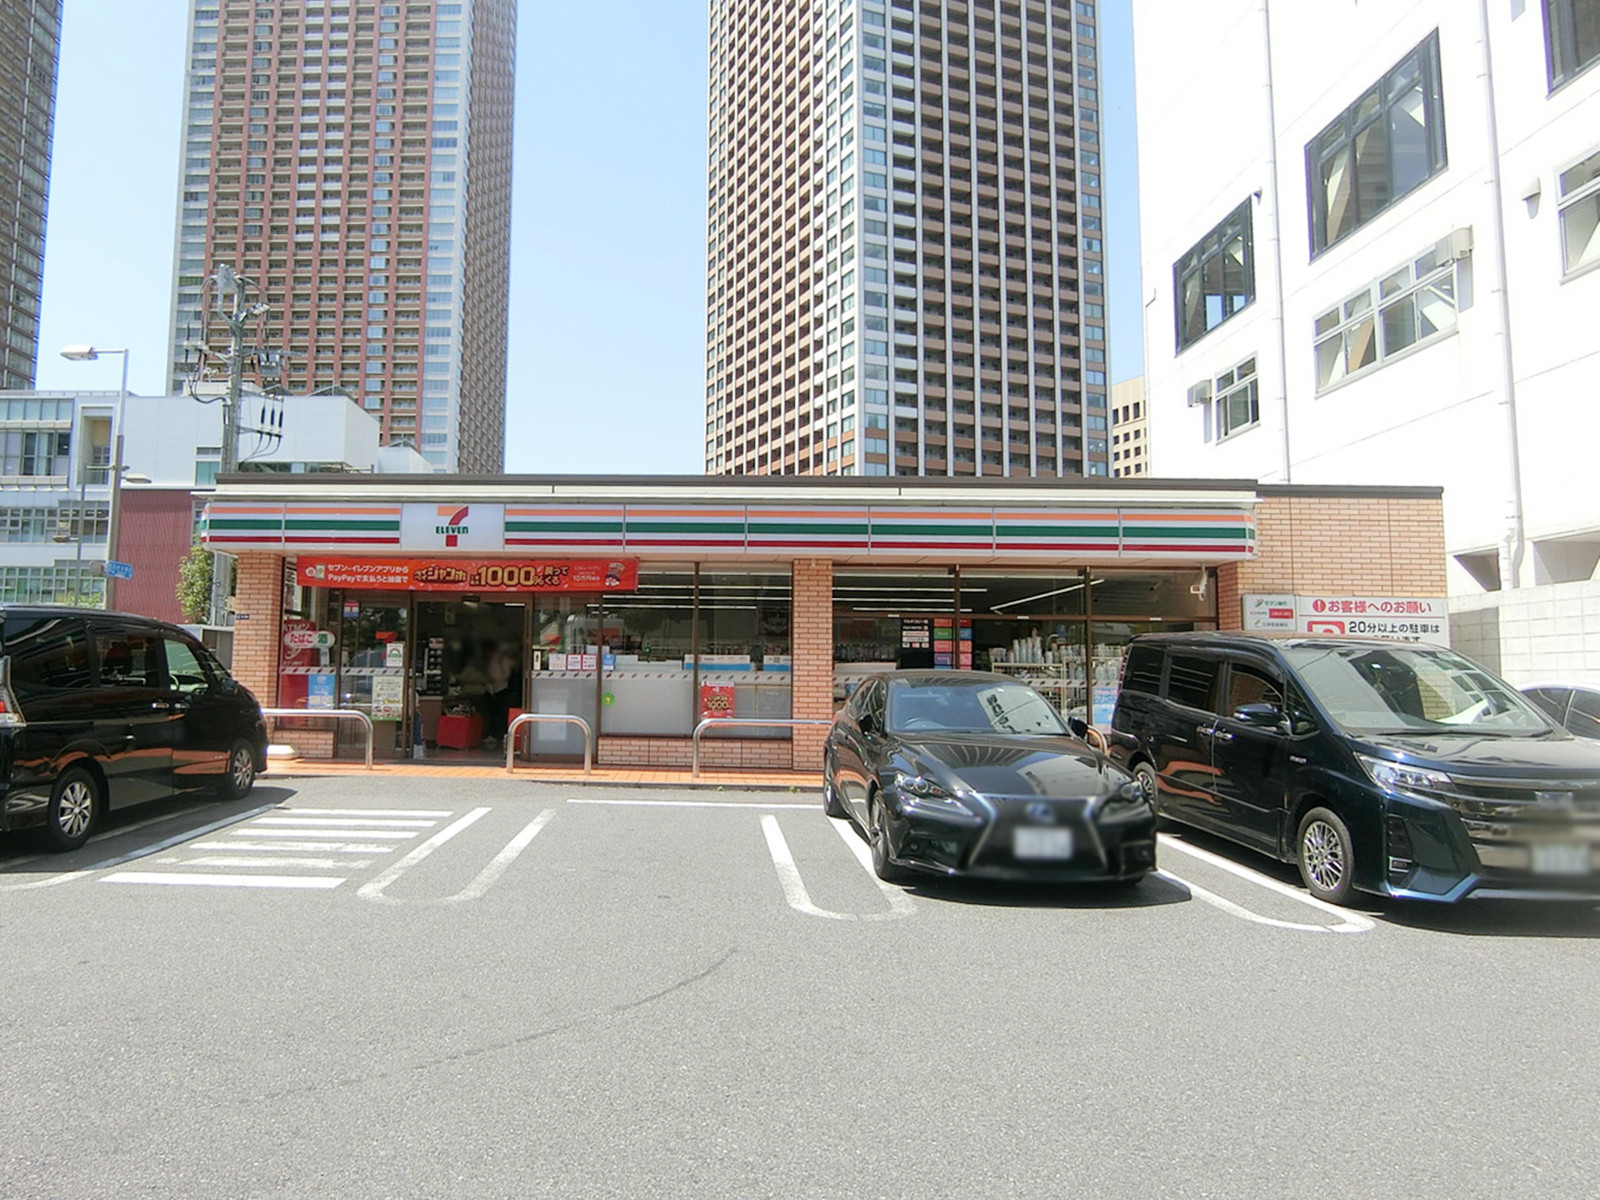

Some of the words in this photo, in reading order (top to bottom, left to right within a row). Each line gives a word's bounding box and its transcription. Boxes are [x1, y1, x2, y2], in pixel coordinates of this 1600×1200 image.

[1327, 600, 1432, 614] お客様へのお願い
[1348, 620, 1441, 634] 20分以上の駐車は
[289, 632, 314, 645] たばこ
